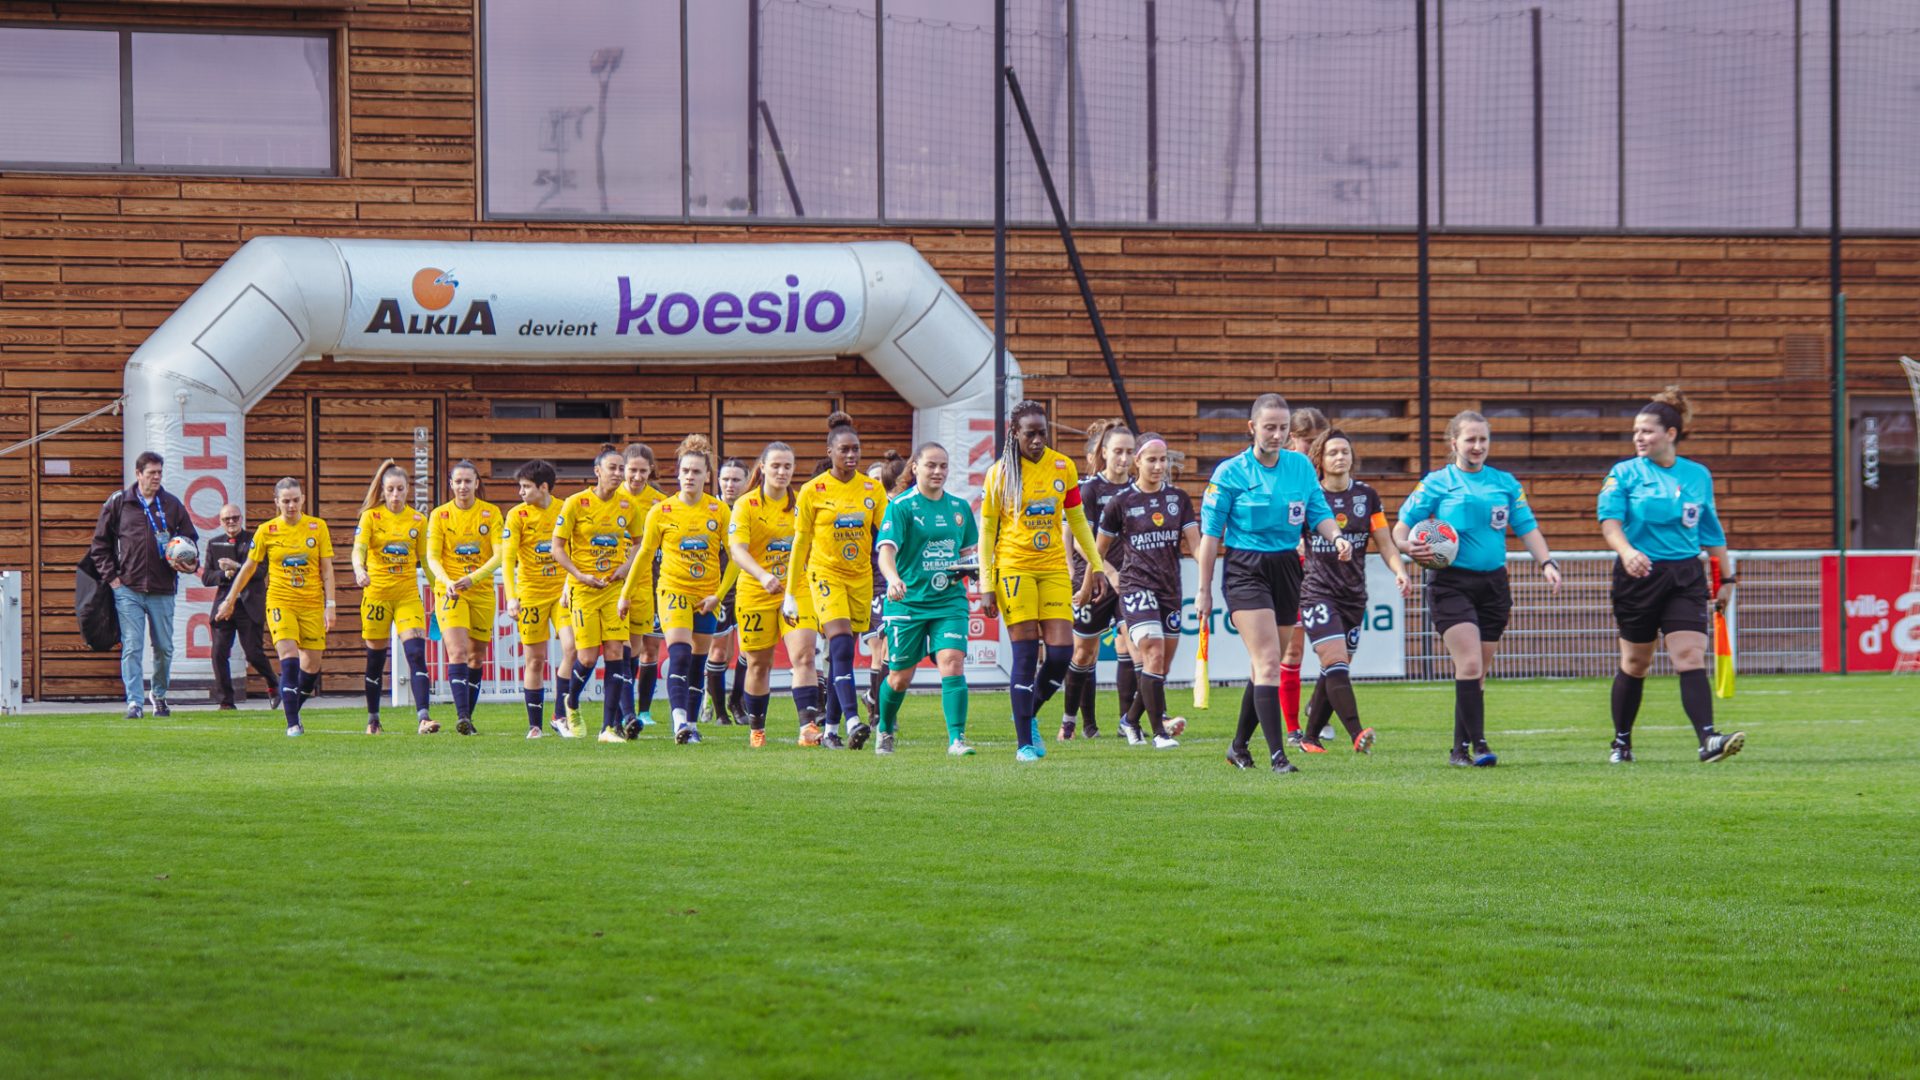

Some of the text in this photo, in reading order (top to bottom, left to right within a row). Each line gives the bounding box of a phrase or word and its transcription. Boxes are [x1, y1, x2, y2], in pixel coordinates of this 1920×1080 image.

[519, 319, 598, 336] devient
[616, 274, 846, 335] koesio
[414, 447, 428, 516] STIAIRE
[1002, 576, 1020, 598] 17
[668, 593, 687, 609] 20
[1135, 589, 1158, 610] 25
[1844, 594, 1889, 617] ville
[273, 608, 281, 622] 8
[366, 604, 385, 621] 28
[521, 607, 539, 624] 23
[574, 608, 584, 627] 11
[742, 613, 763, 632] 22
[1315, 603, 1329, 624] 3
[892, 626, 899, 647] 1
